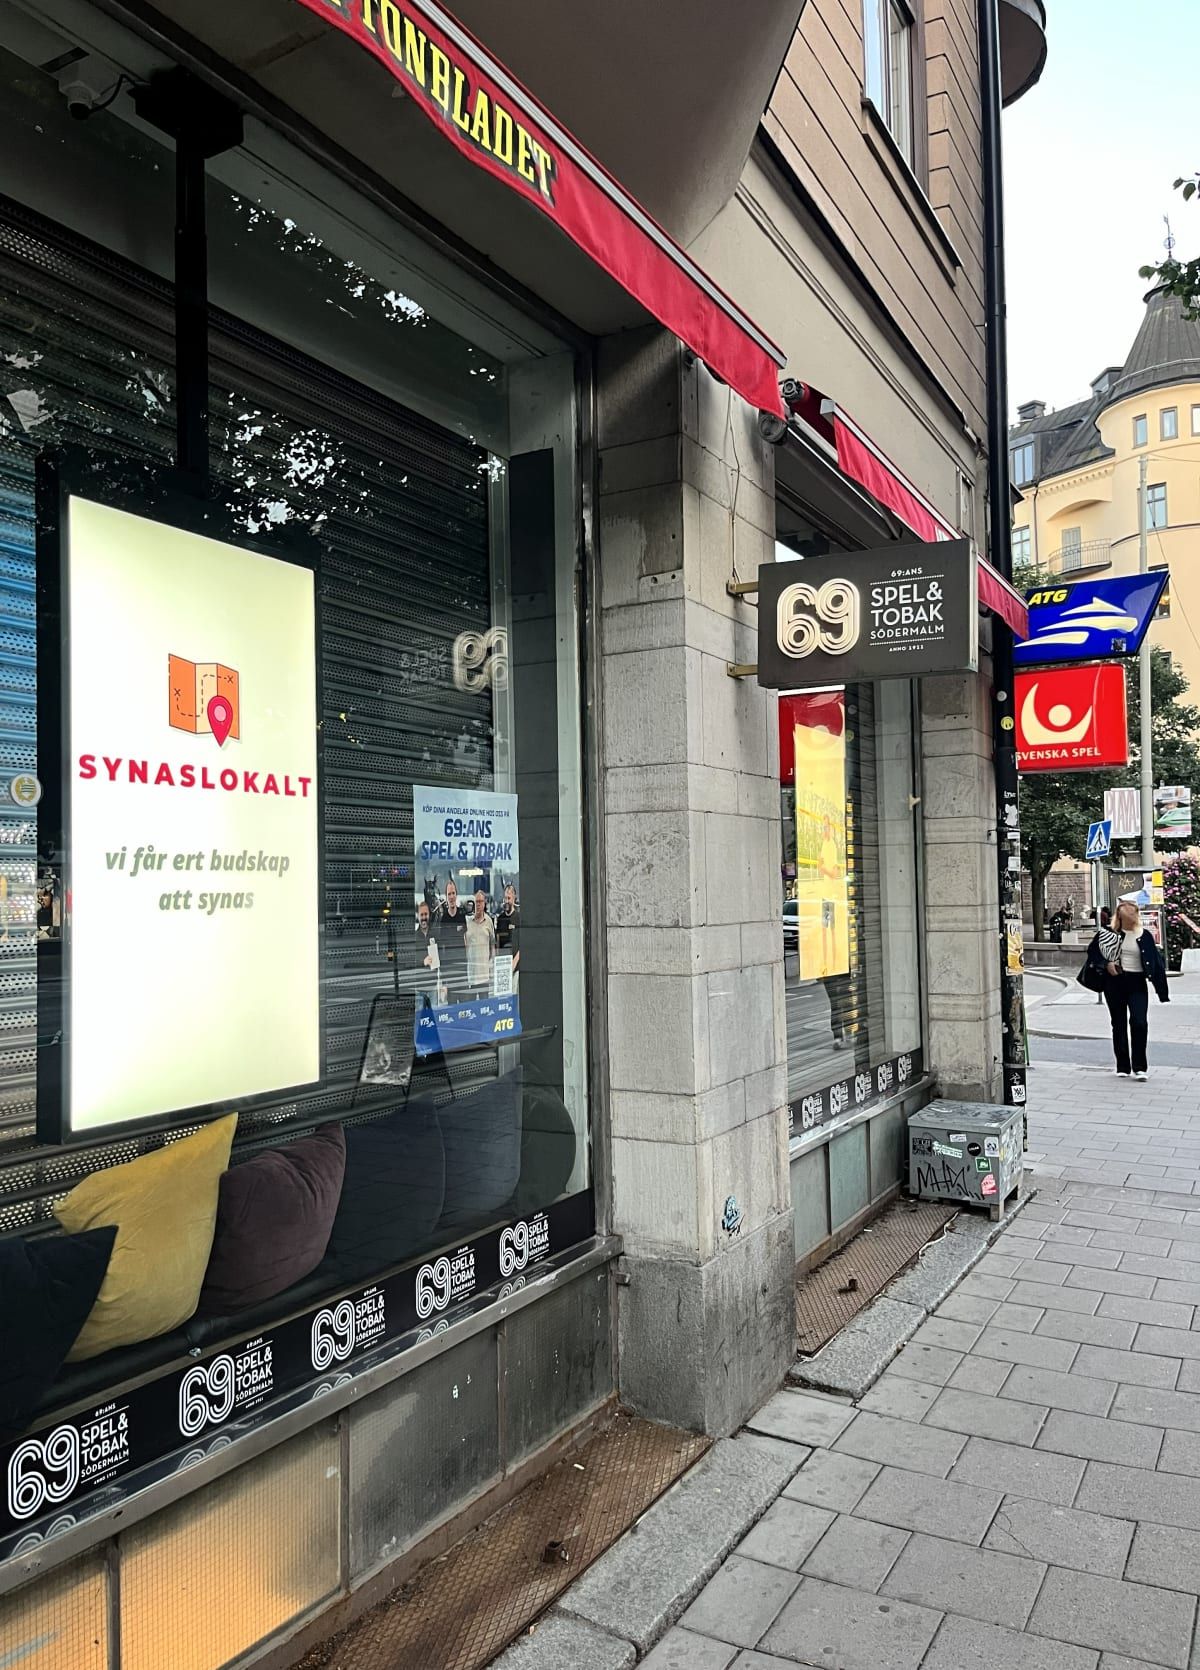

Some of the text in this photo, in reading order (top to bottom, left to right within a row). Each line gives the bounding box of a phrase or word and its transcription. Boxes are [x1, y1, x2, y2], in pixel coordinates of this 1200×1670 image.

[890, 567, 923, 578] 69:ANS
[1028, 589, 1068, 606] ATG
[776, 577, 861, 660] 69
[870, 603, 944, 627] TOBAK
[870, 624, 945, 640] SÖDERMALM
[1016, 746, 1101, 760] SVENSKA SPEL
[78, 754, 312, 797] SYNASLOKALT
[444, 818, 493, 839] 69:ANS
[105, 845, 290, 877] vi får ert budskap
[421, 841, 513, 862] SPEL & TOBAK
[159, 889, 254, 916] att synas
[494, 1018, 514, 1033] ATG
[801, 1096, 815, 1129] 69
[500, 1221, 529, 1277] 69
[528, 1231, 549, 1249] TOBAK
[416, 1257, 451, 1318] 69
[451, 1266, 475, 1287] TOBAK
[312, 1300, 355, 1371] 69
[355, 1309, 385, 1334] TOBAK
[236, 1362, 273, 1391] TOBAK
[179, 1355, 235, 1437] 69
[81, 1430, 129, 1466] TOBAK
[8, 1424, 80, 1520] 69
[81, 1449, 130, 1478] SÖDERMALM
